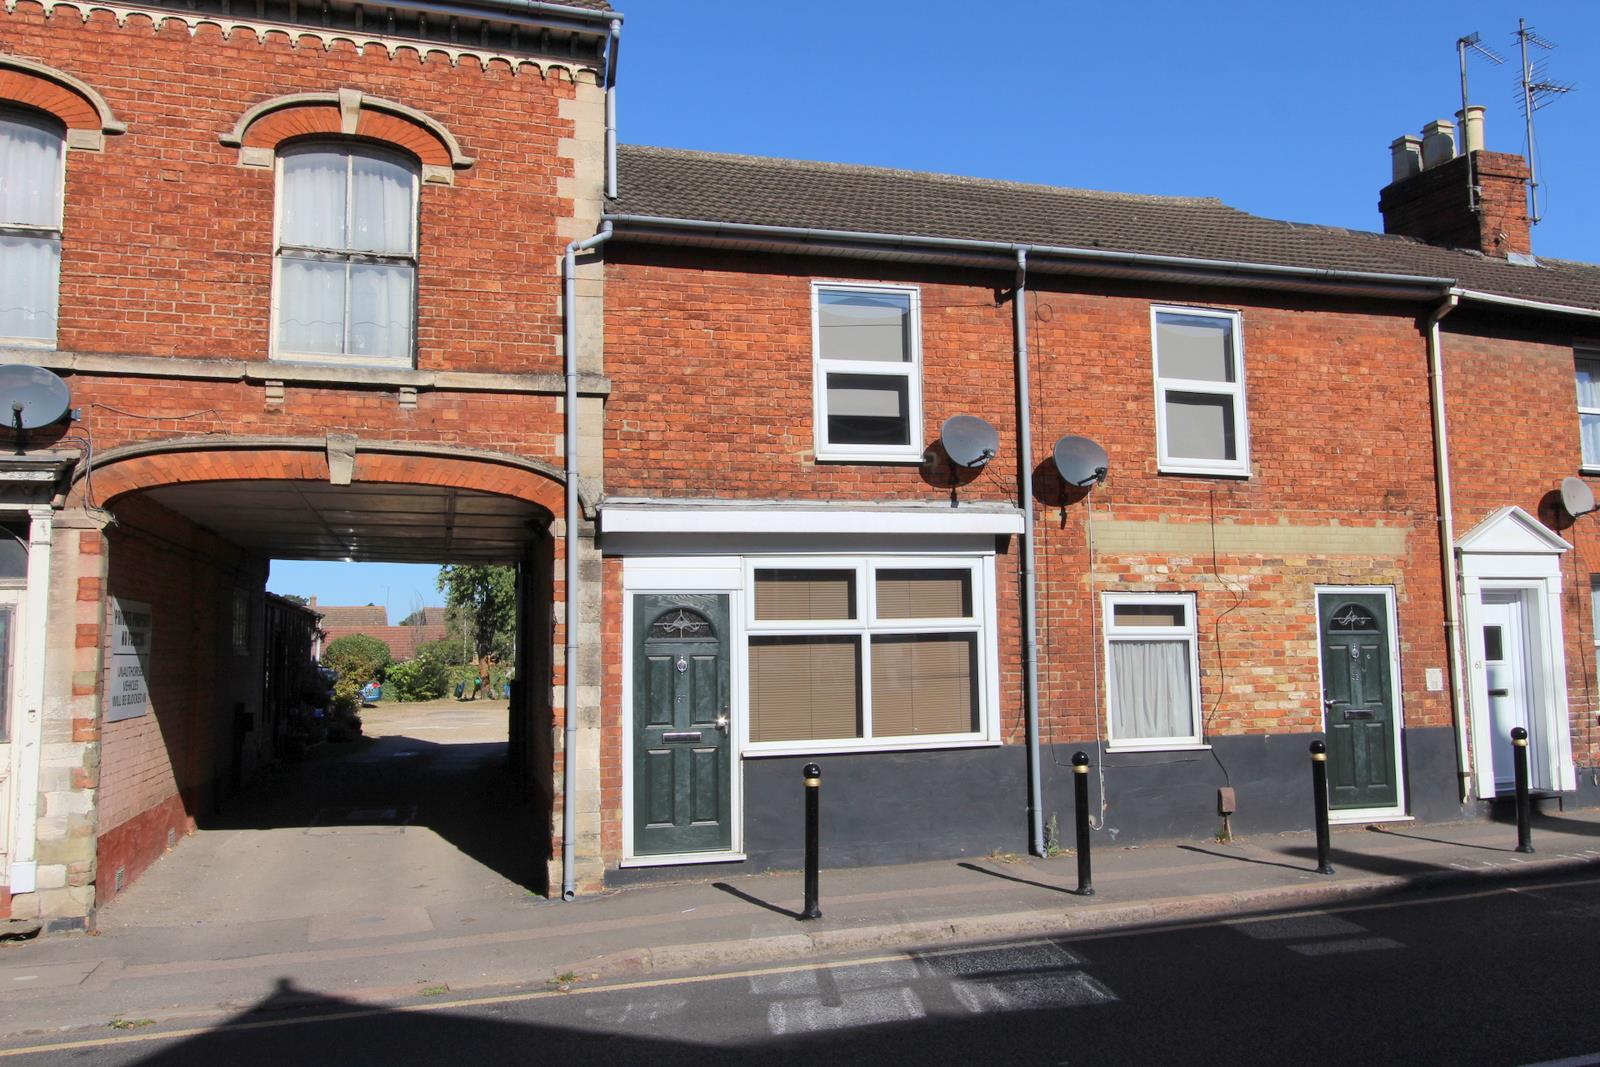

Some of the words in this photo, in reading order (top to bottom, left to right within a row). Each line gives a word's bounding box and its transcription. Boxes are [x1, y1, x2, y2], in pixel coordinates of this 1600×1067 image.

[122, 680, 139, 691] VEHICLES
[112, 695, 121, 707] WILL
[121, 694, 127, 706] BE
[127, 693, 142, 705] BLOCKED
